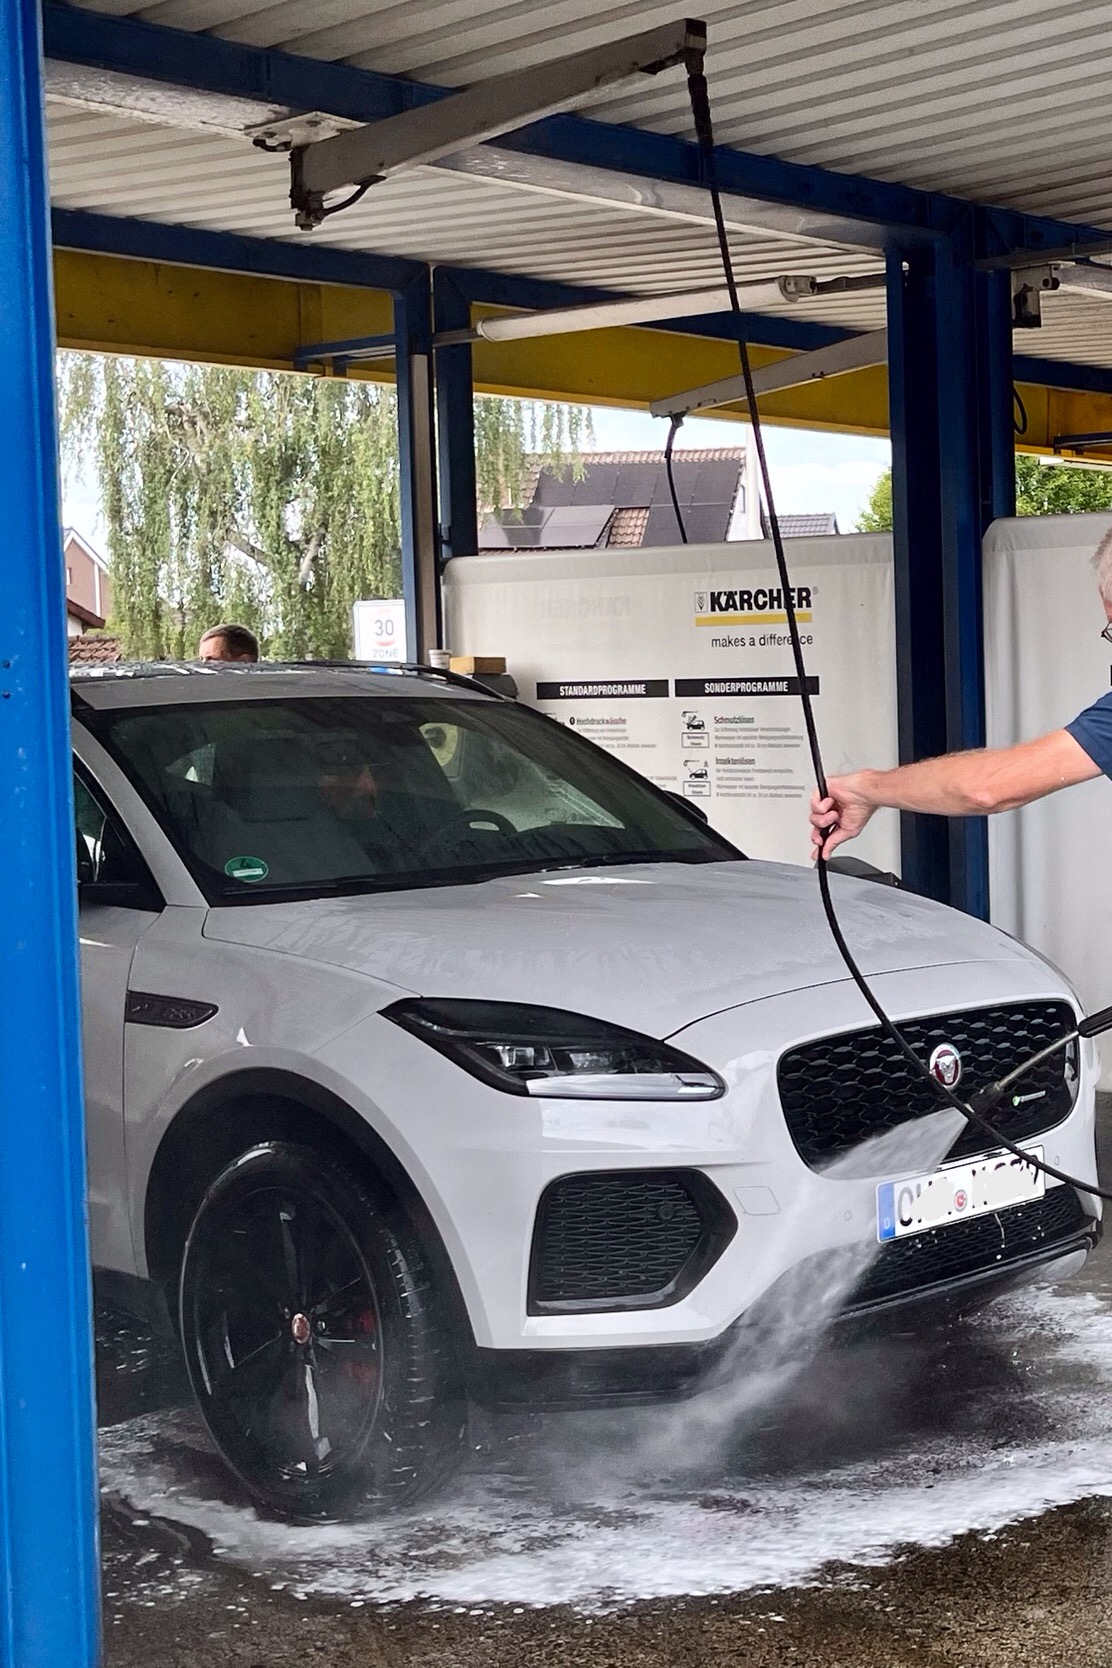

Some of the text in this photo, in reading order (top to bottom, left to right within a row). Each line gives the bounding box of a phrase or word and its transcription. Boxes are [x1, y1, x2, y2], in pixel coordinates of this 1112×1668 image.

[374, 619, 394, 636] 30
[711, 633, 813, 648] makes a differece
[373, 649, 399, 659] ZONE
[559, 684, 647, 696] STANDARDPROGRAMME
[704, 681, 789, 694] SONDERPROGRAMME
